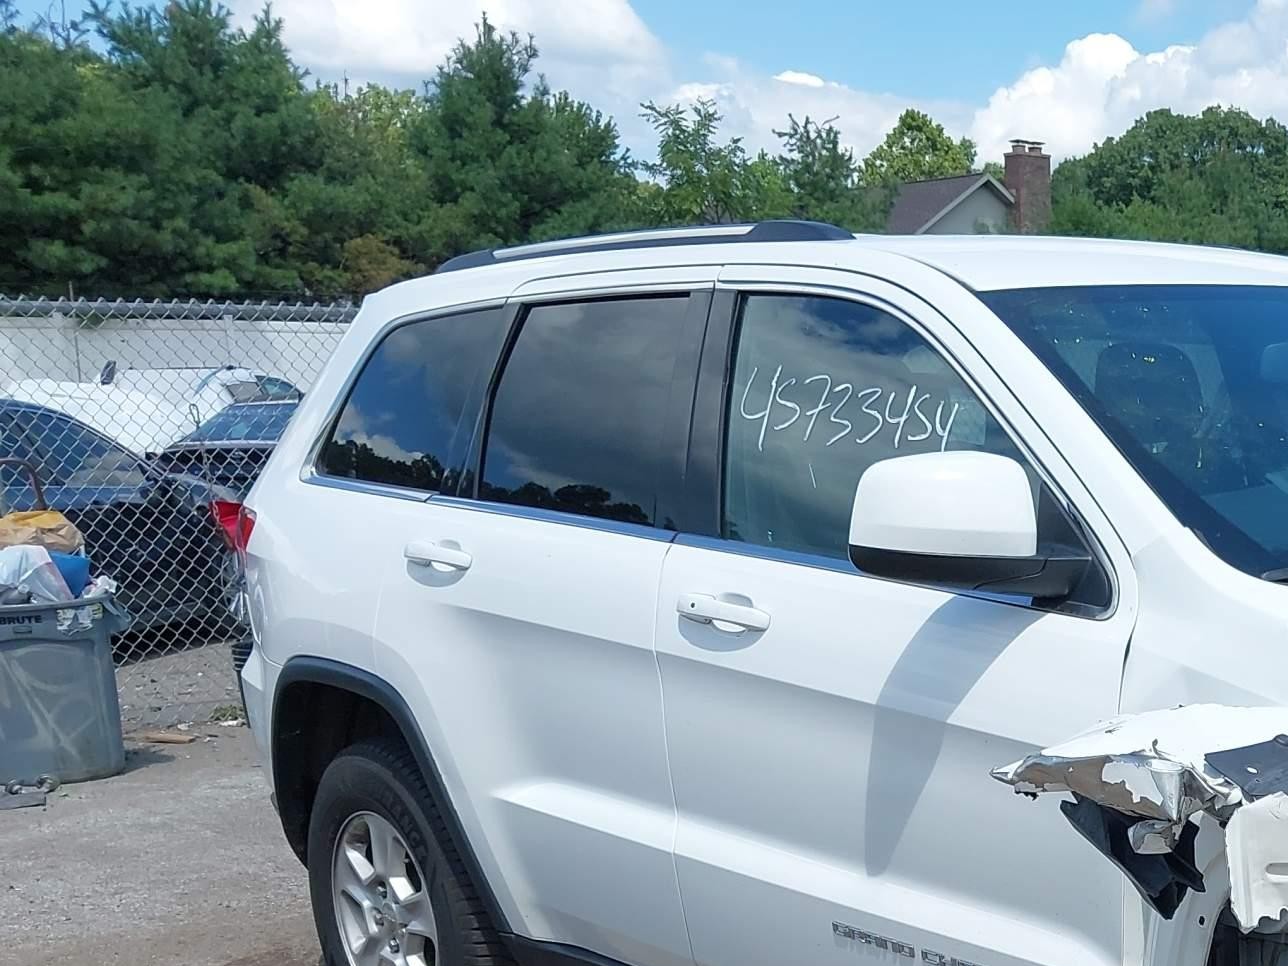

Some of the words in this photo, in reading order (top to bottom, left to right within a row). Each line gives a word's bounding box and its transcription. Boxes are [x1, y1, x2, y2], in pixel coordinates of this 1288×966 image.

[739, 365, 960, 452] 45733454
[0, 614, 42, 625] BRUTE
[831, 920, 916, 958] GRAND
